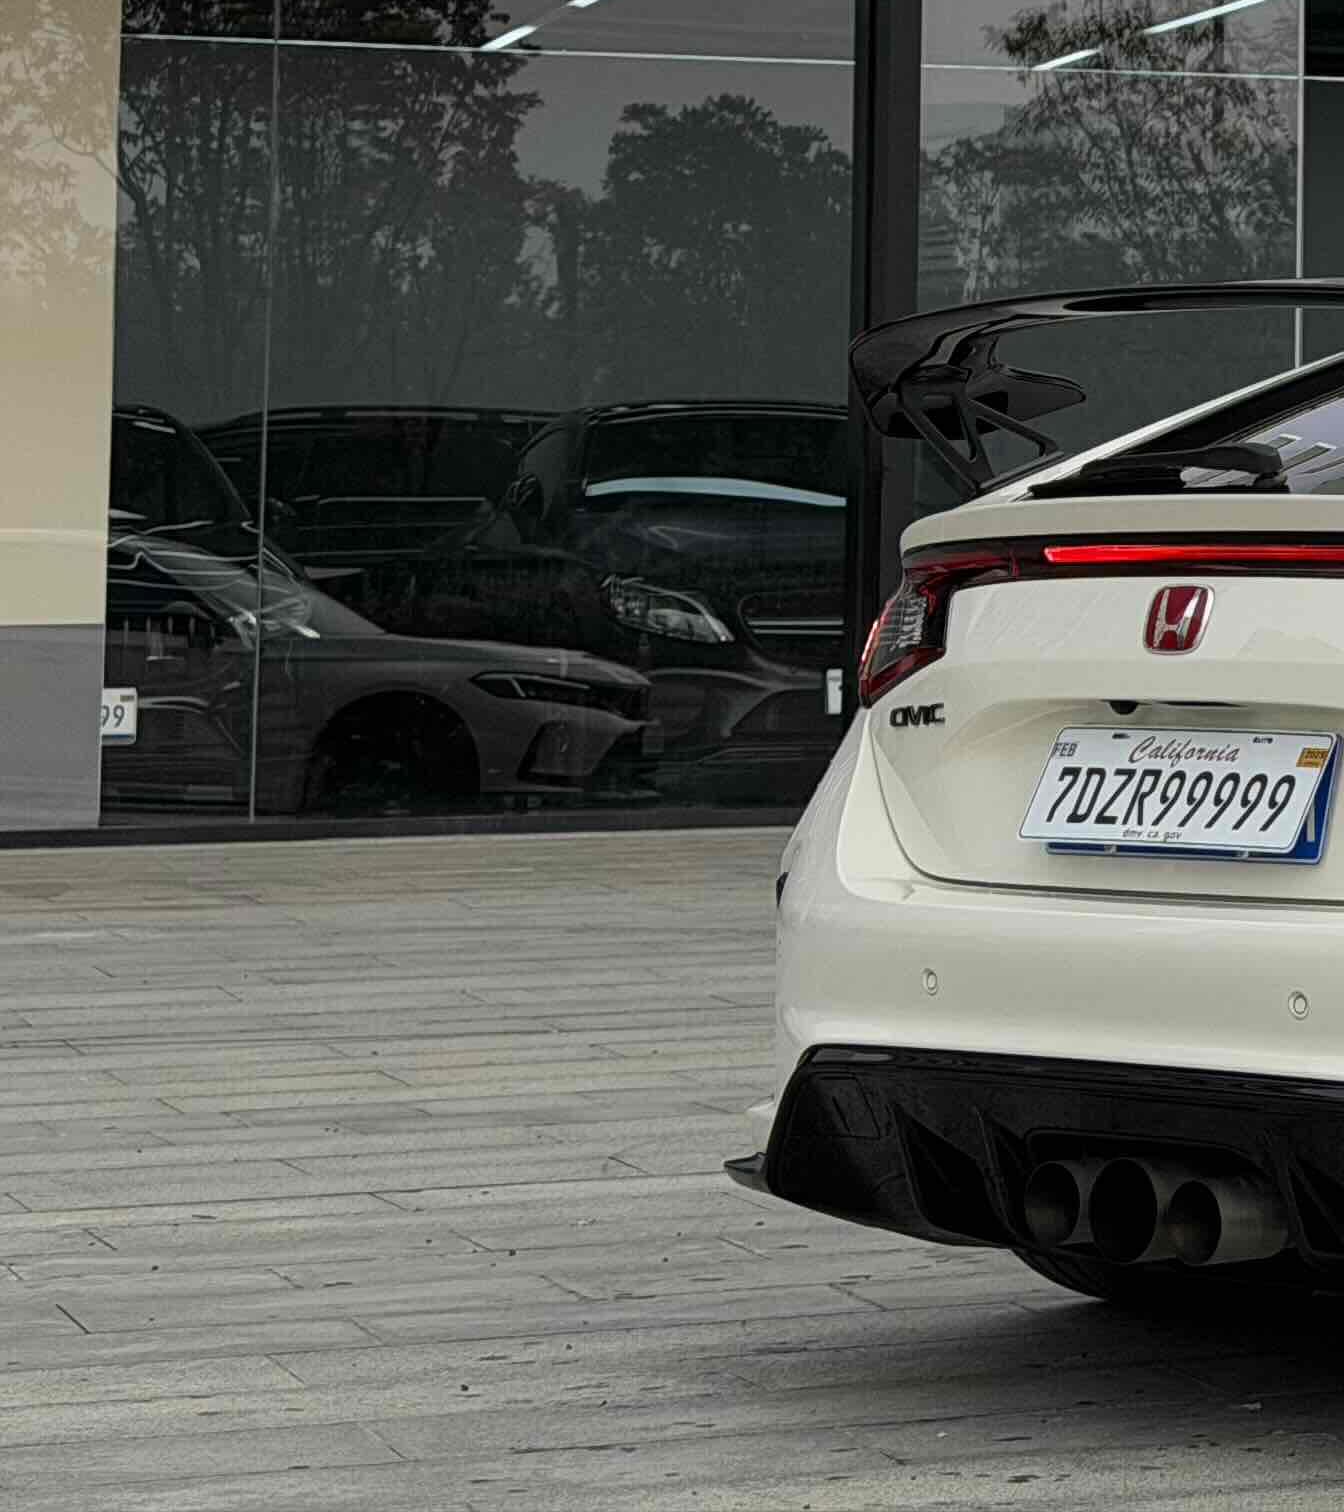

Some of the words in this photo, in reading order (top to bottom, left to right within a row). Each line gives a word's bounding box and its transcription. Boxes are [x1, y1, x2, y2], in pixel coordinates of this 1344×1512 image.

[1052, 742, 1078, 757] FEB
[1128, 735, 1240, 767] California
[1046, 767, 1296, 832] 7DZR99999
